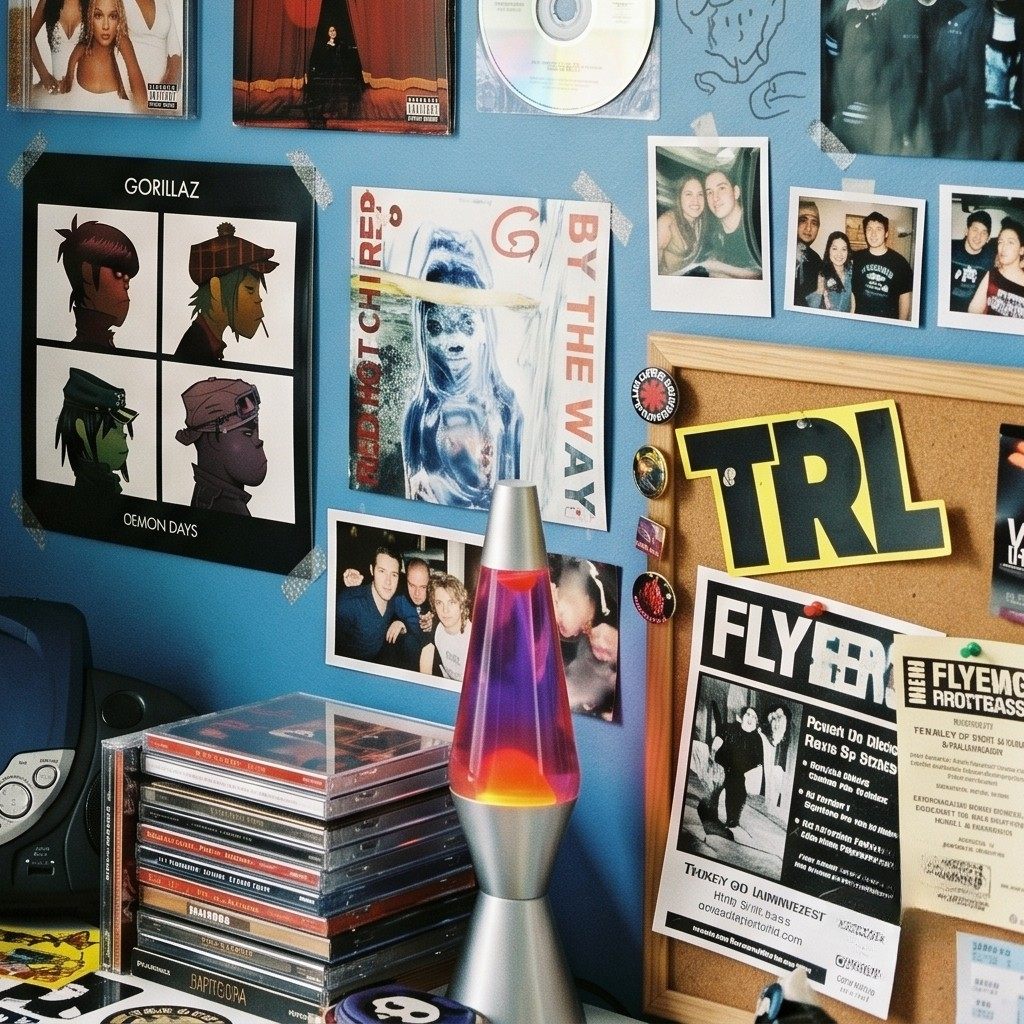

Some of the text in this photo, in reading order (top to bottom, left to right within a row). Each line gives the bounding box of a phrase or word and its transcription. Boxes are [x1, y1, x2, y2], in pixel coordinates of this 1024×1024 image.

[124, 176, 201, 200] GORILLAZ
[356, 338, 383, 413] HOT
[564, 213, 601, 517] BY THE WAY
[684, 408, 945, 570] TRL
[169, 519, 199, 539] DAYS
